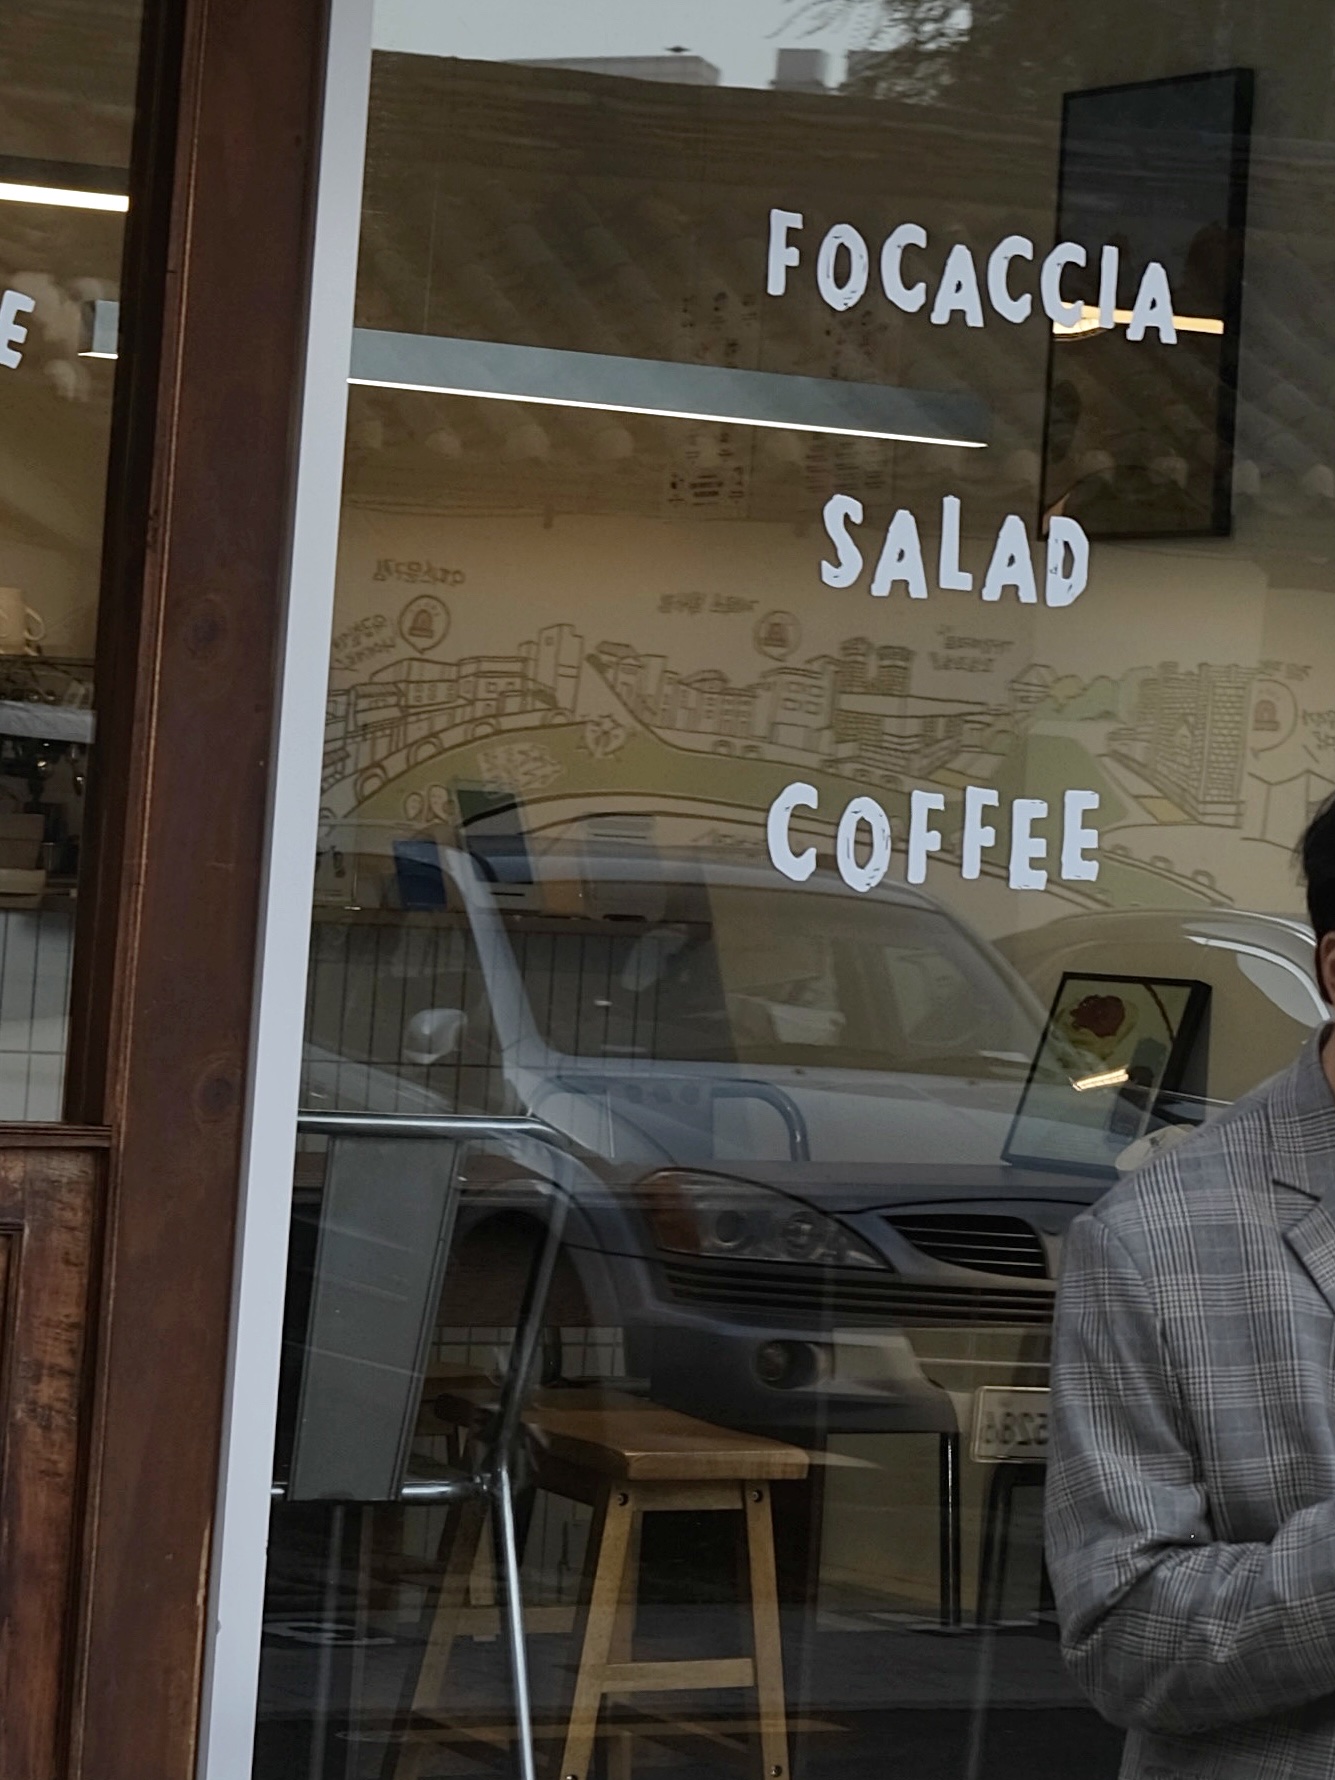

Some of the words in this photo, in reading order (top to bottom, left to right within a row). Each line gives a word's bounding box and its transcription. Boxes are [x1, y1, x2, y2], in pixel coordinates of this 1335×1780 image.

[767, 209, 1177, 344] FOCACCIA
[821, 494, 1089, 607] SALAD
[767, 782, 1100, 893] COFFEE
